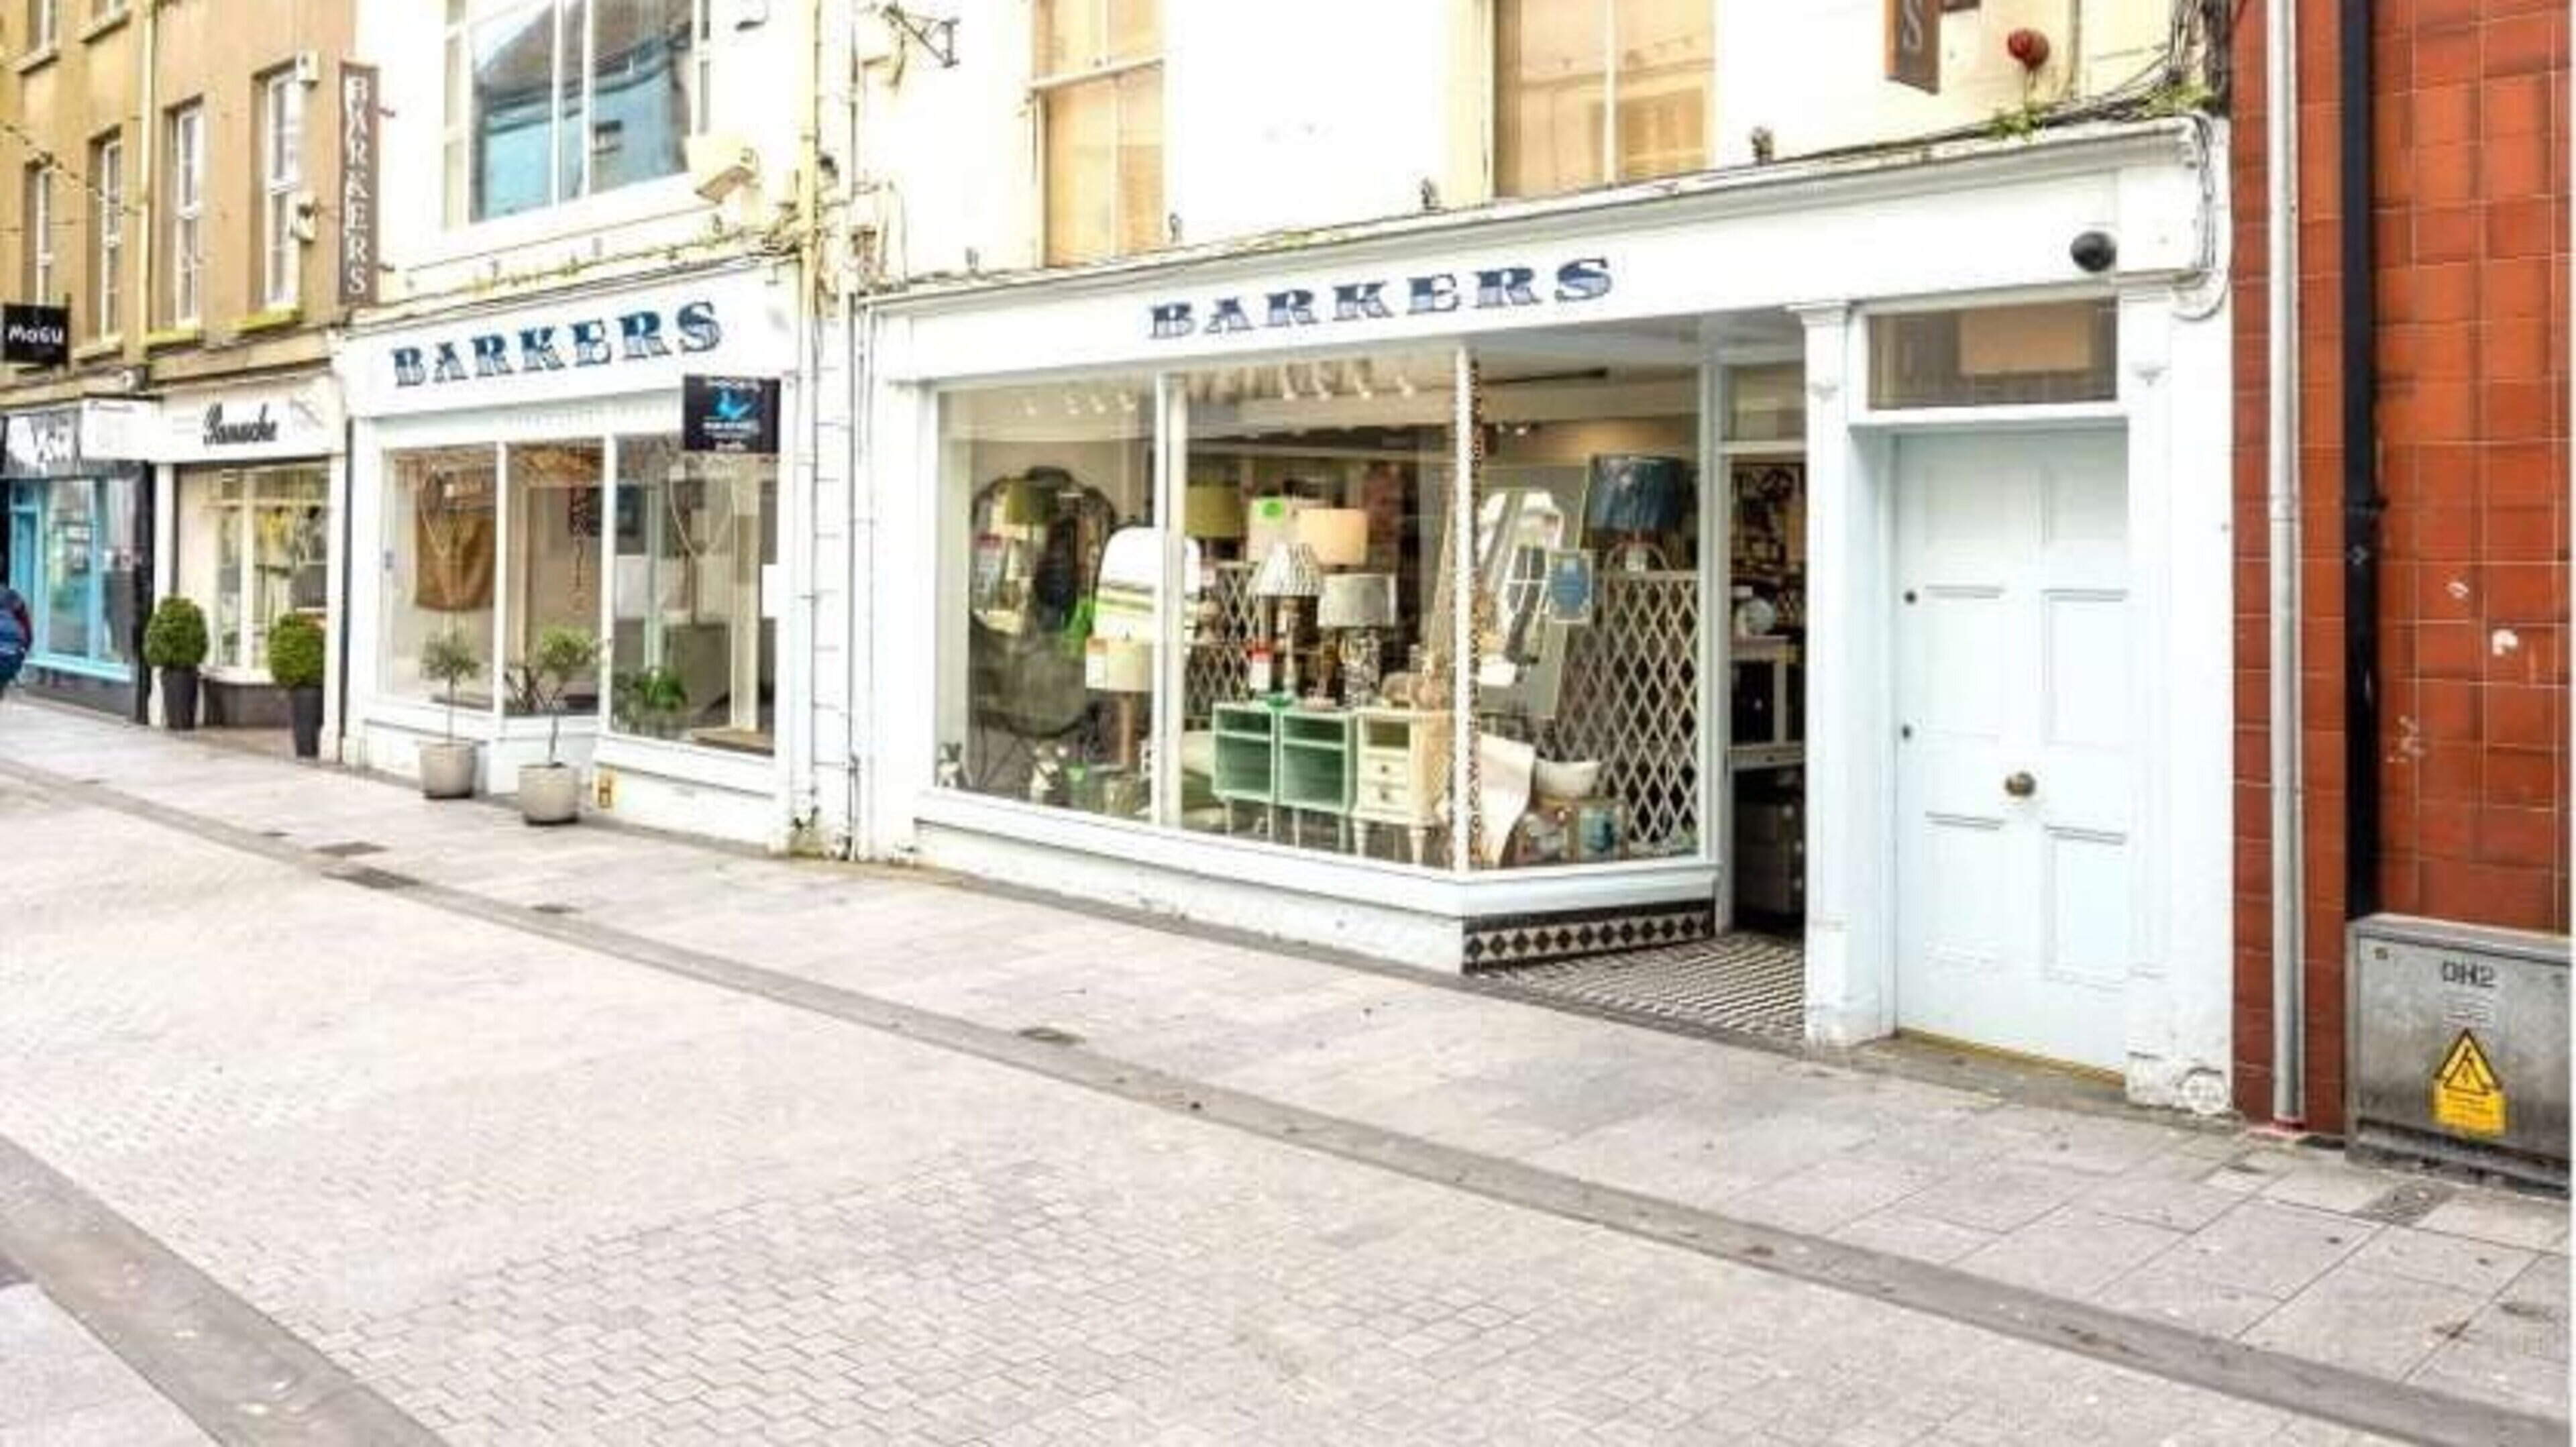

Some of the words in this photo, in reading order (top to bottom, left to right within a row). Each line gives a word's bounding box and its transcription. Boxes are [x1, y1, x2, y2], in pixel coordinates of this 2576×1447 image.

[344, 75, 370, 294] BARKERS
[1149, 257, 1613, 338] BARKERS
[390, 301, 722, 388] BARKERS
